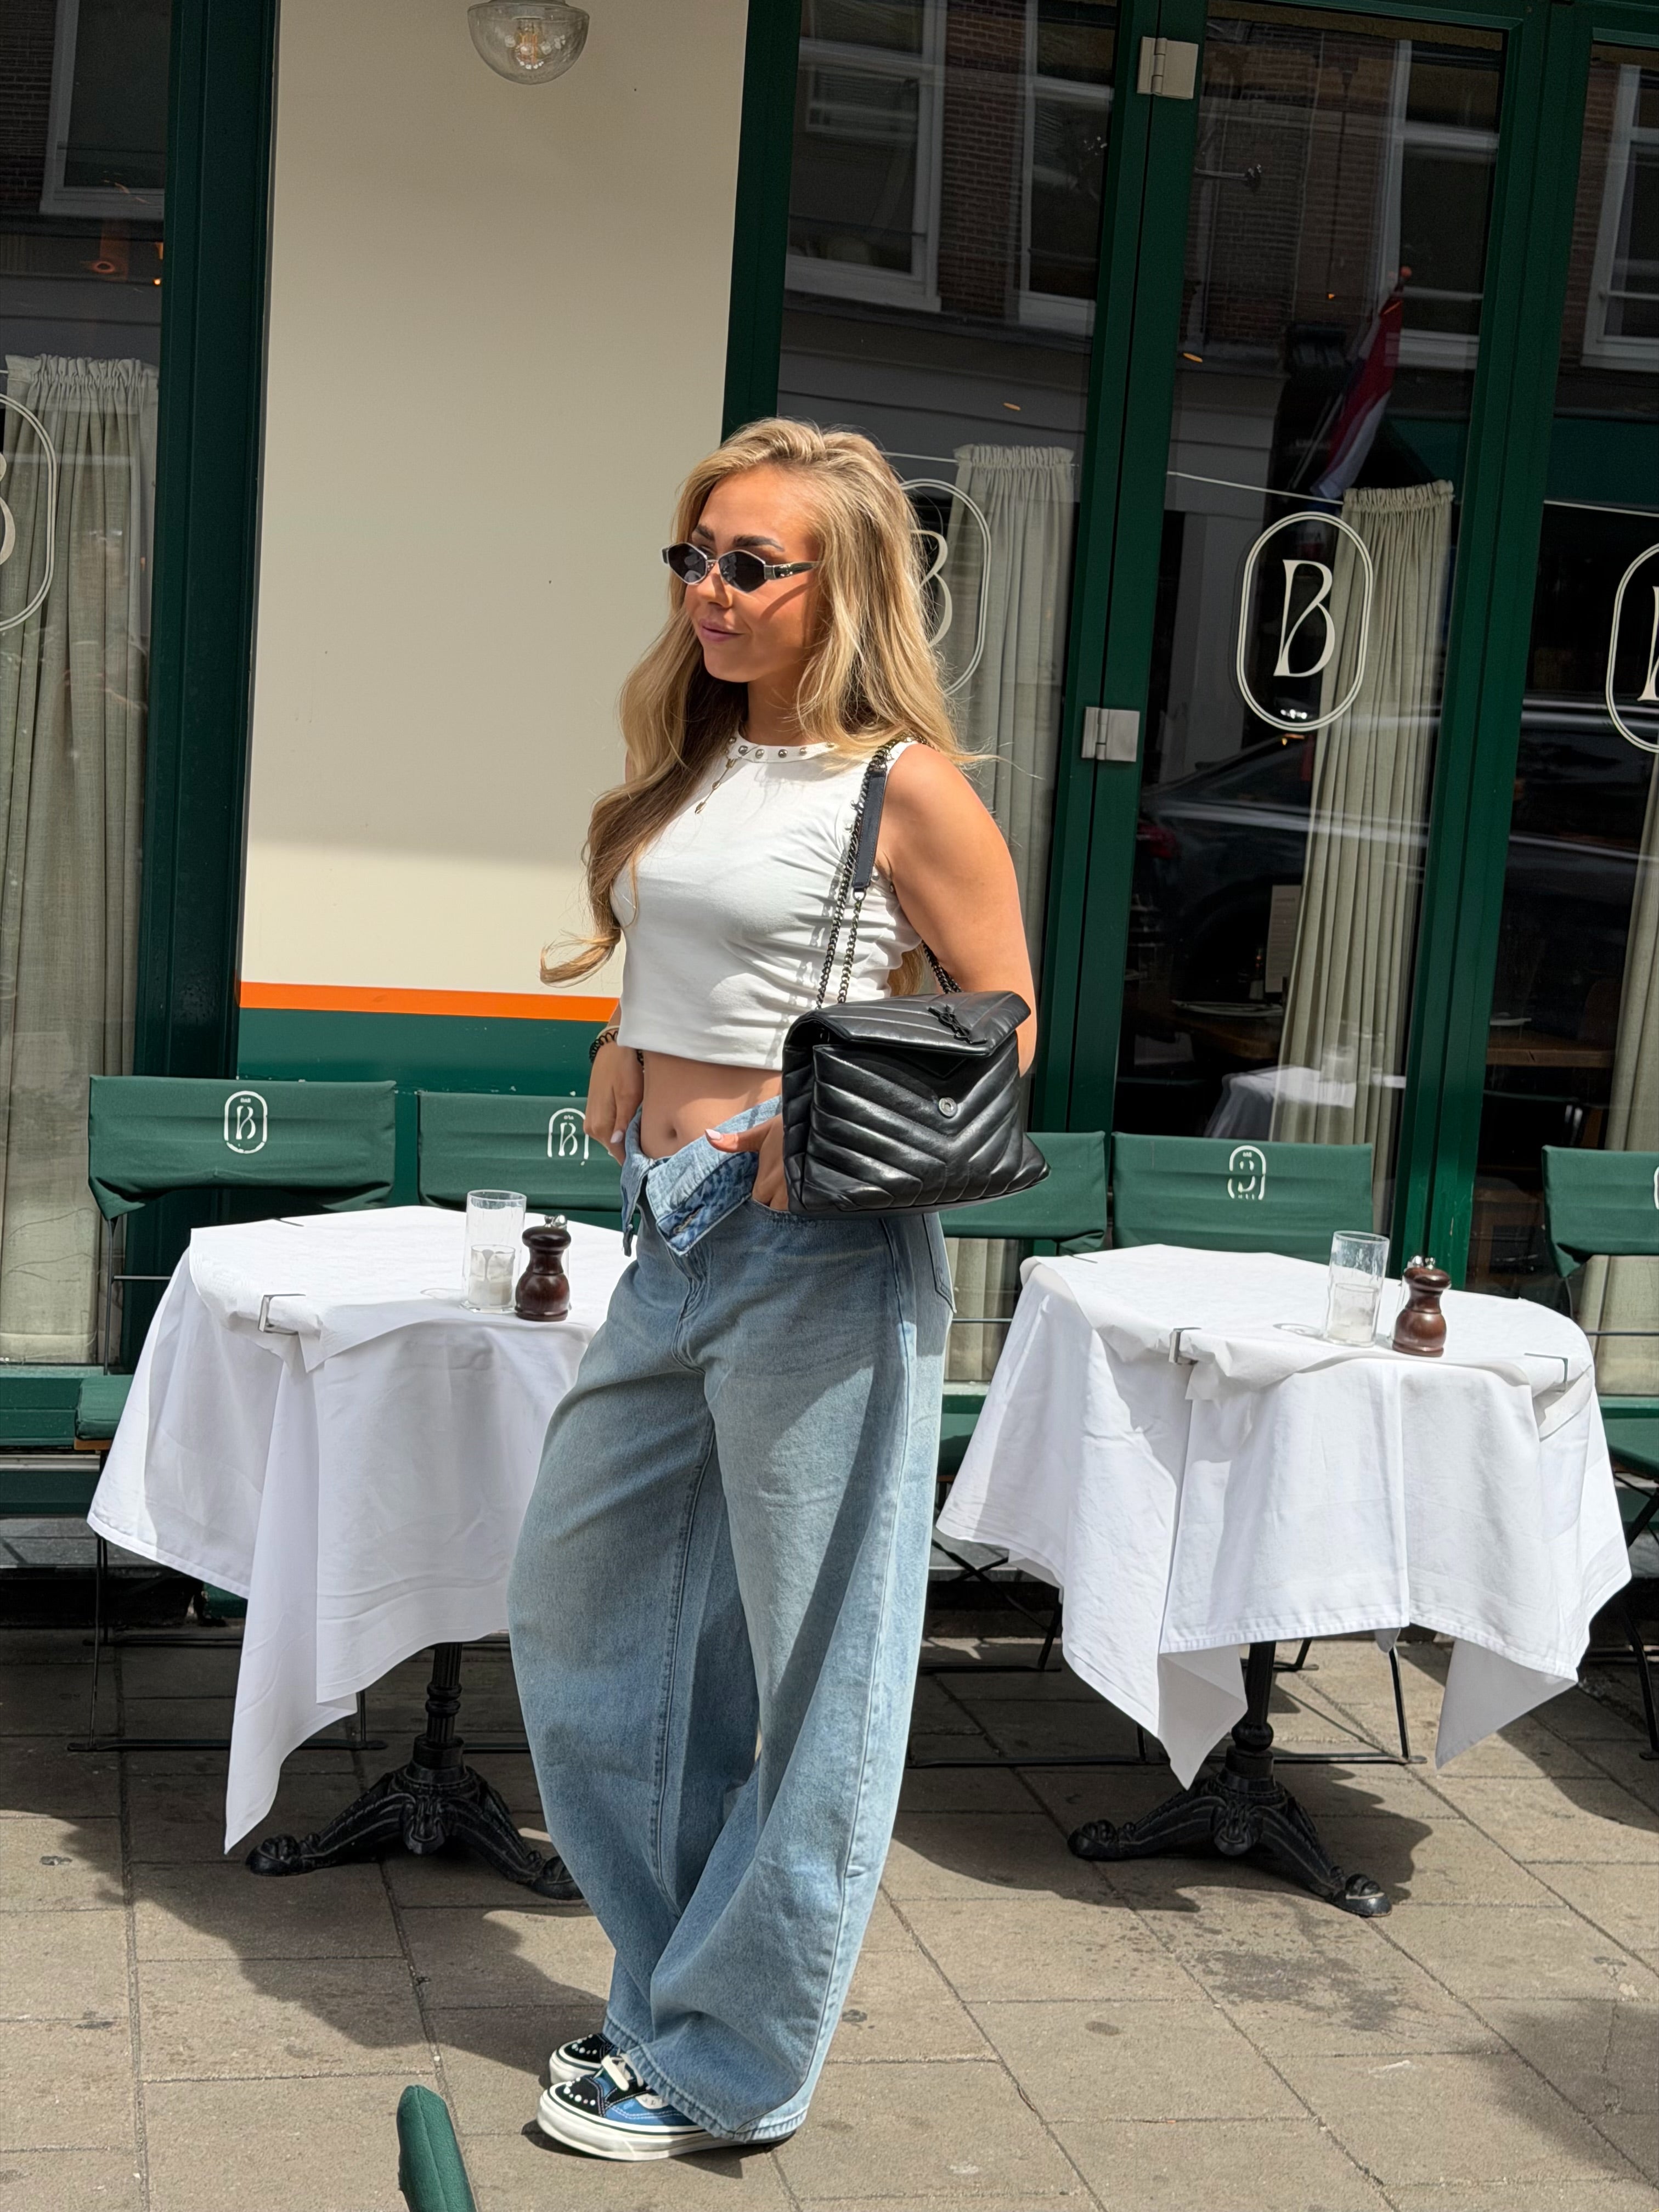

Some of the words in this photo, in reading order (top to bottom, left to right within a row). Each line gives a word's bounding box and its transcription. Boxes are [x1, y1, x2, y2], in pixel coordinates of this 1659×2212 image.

[1273, 558, 1336, 678] B
[235, 1105, 256, 1140] B
[558, 1122, 578, 1156] B
